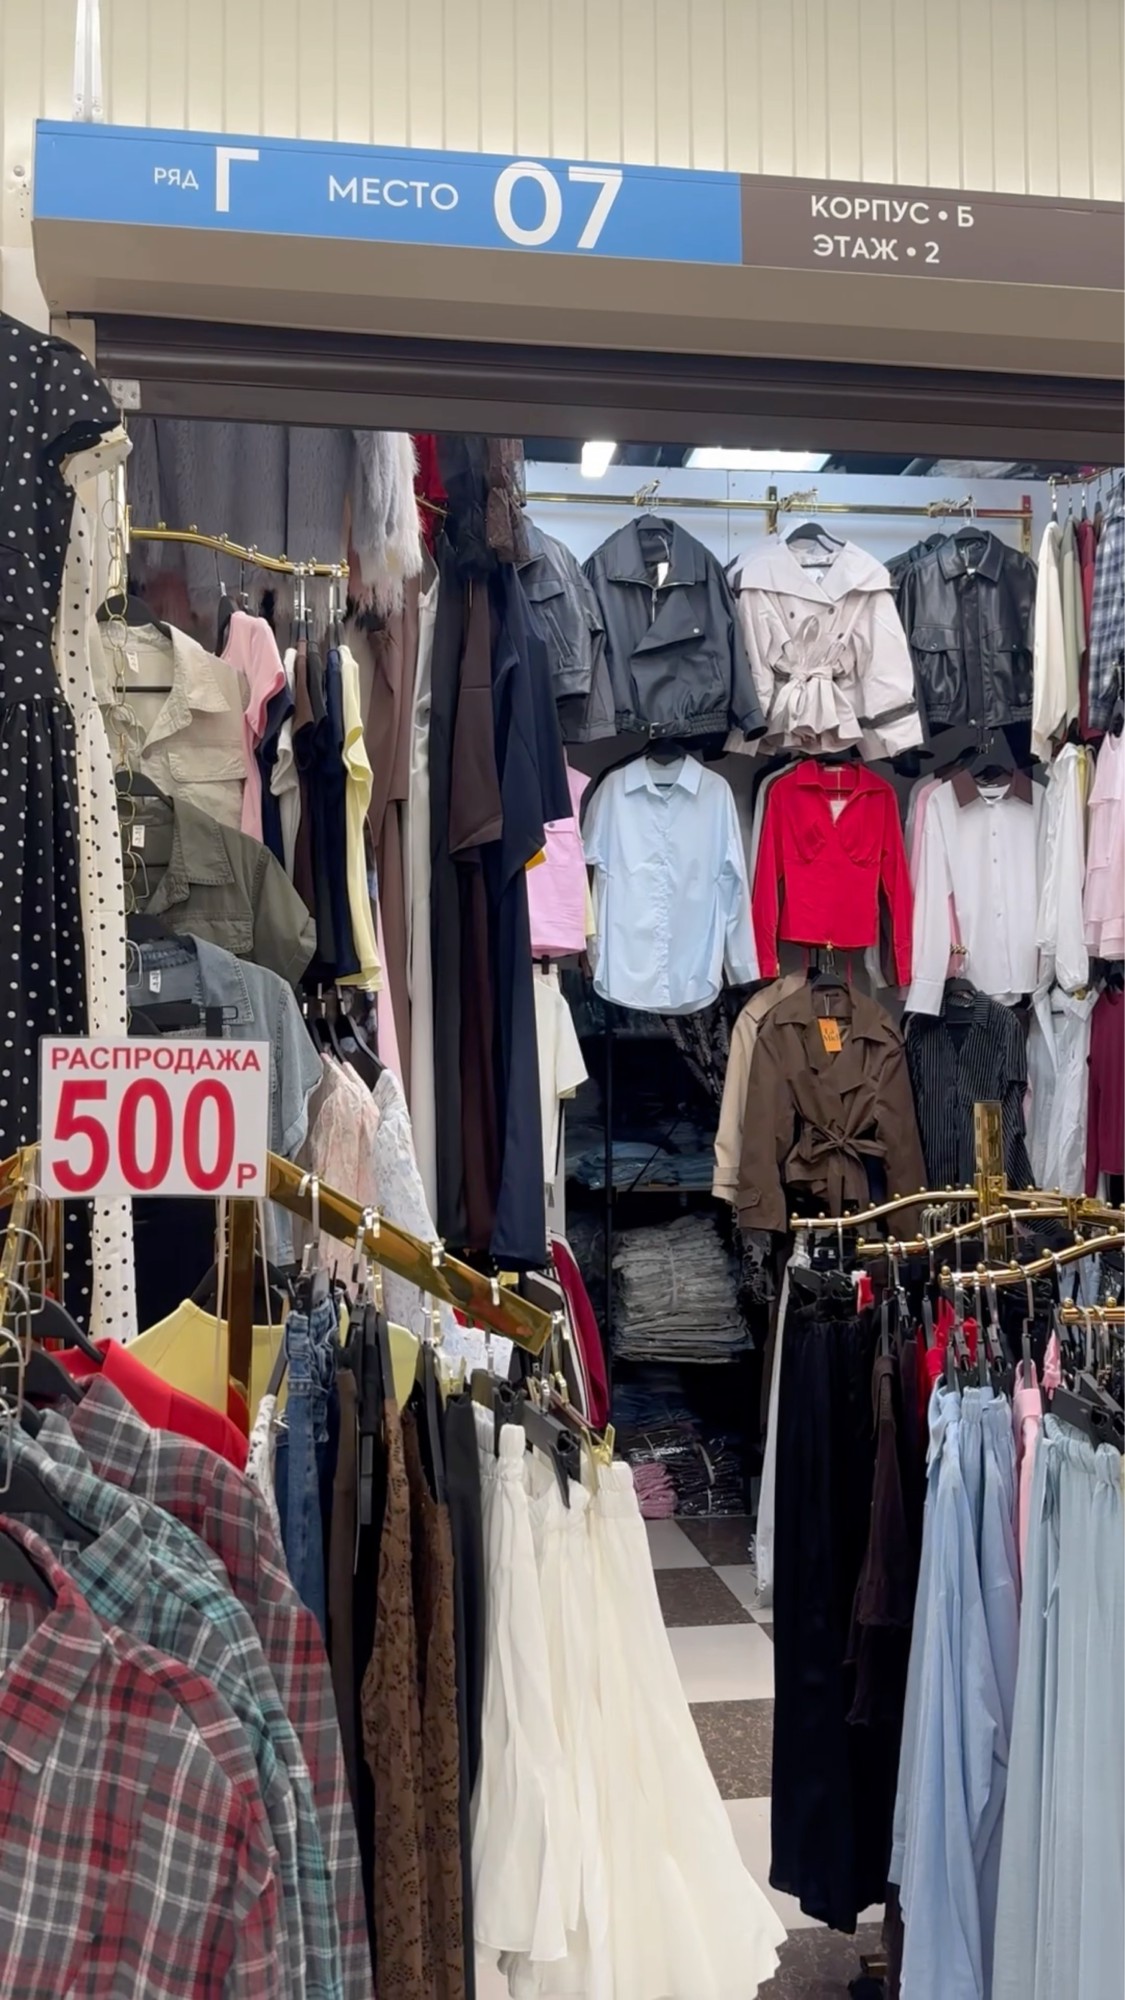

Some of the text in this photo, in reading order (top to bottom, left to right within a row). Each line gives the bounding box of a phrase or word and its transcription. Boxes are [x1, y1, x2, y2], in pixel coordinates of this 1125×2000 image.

[154, 146, 623, 249] РЯД Г МЕСТО 07
[811, 195, 974, 227] КОРПУС Б
[813, 234, 940, 263] ЭТАЖ 2
[51, 1047, 261, 1074] РАСПРОДАЖА
